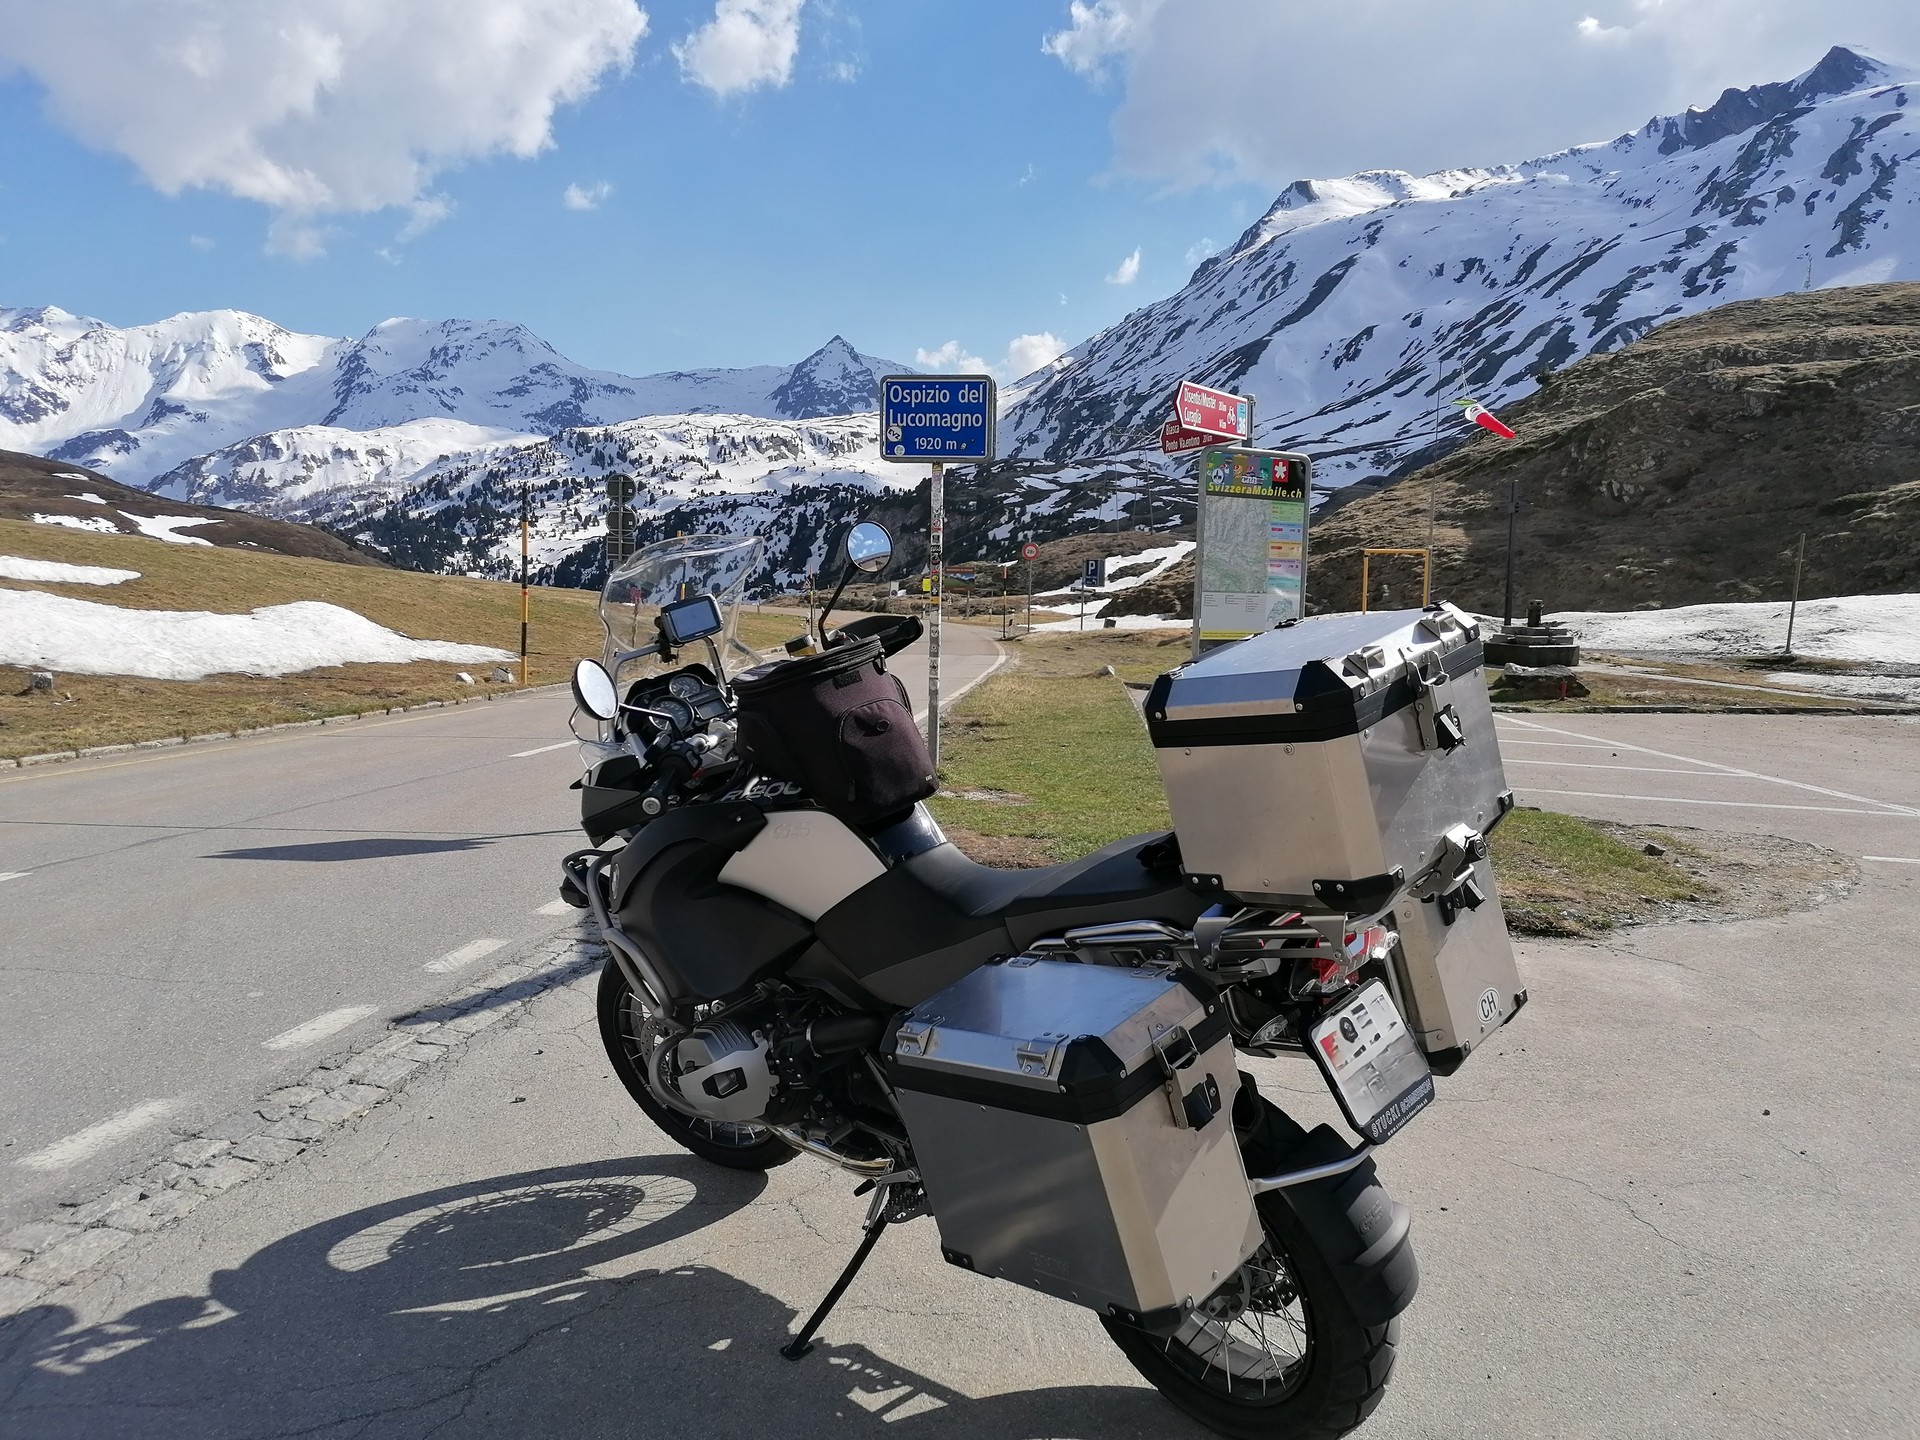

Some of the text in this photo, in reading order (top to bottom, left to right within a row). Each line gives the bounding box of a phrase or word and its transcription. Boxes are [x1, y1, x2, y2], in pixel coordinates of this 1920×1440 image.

[889, 384, 983, 408] Ospizio del
[889, 408, 983, 432] Lucomagno
[888, 428, 901, 440] EVZ
[914, 437, 942, 450] 1920
[946, 440, 957, 450] m
[1207, 481, 1303, 499] SvizzeraMobile.ch
[1088, 560, 1096, 575] P
[1480, 991, 1497, 1019] CH
[1371, 1103, 1401, 1138] STUCKI
